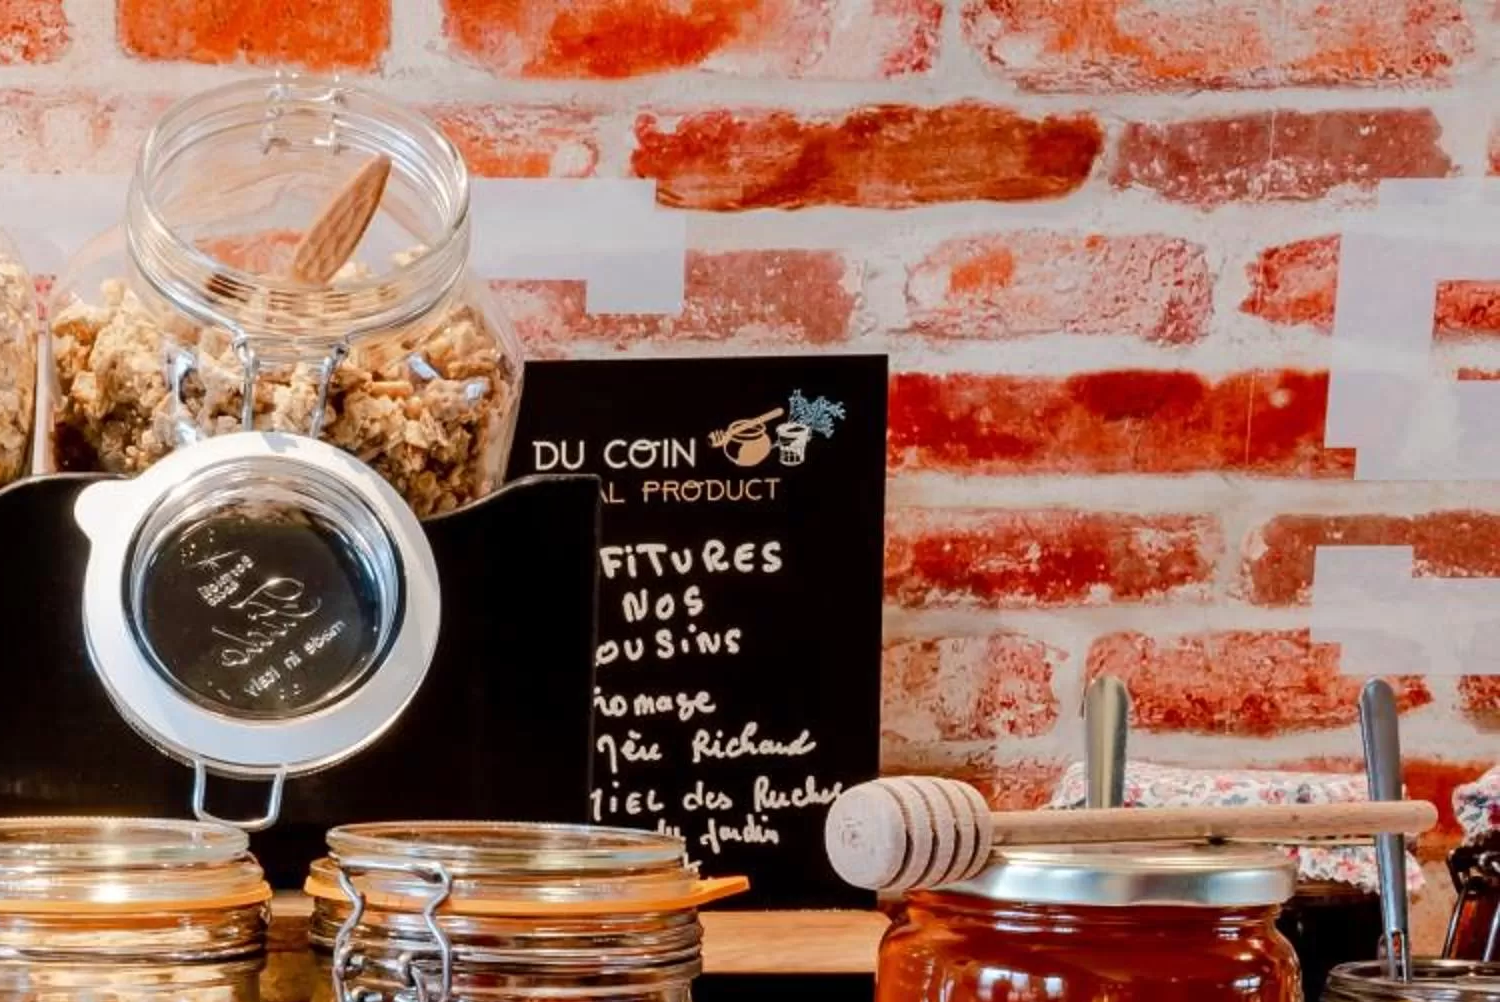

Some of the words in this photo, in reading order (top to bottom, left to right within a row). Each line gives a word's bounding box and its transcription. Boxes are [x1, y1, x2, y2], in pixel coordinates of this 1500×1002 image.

[532, 439, 585, 471] DU
[603, 438, 696, 469] COIN
[642, 477, 781, 503] PRODUCT
[593, 686, 716, 722] romage
